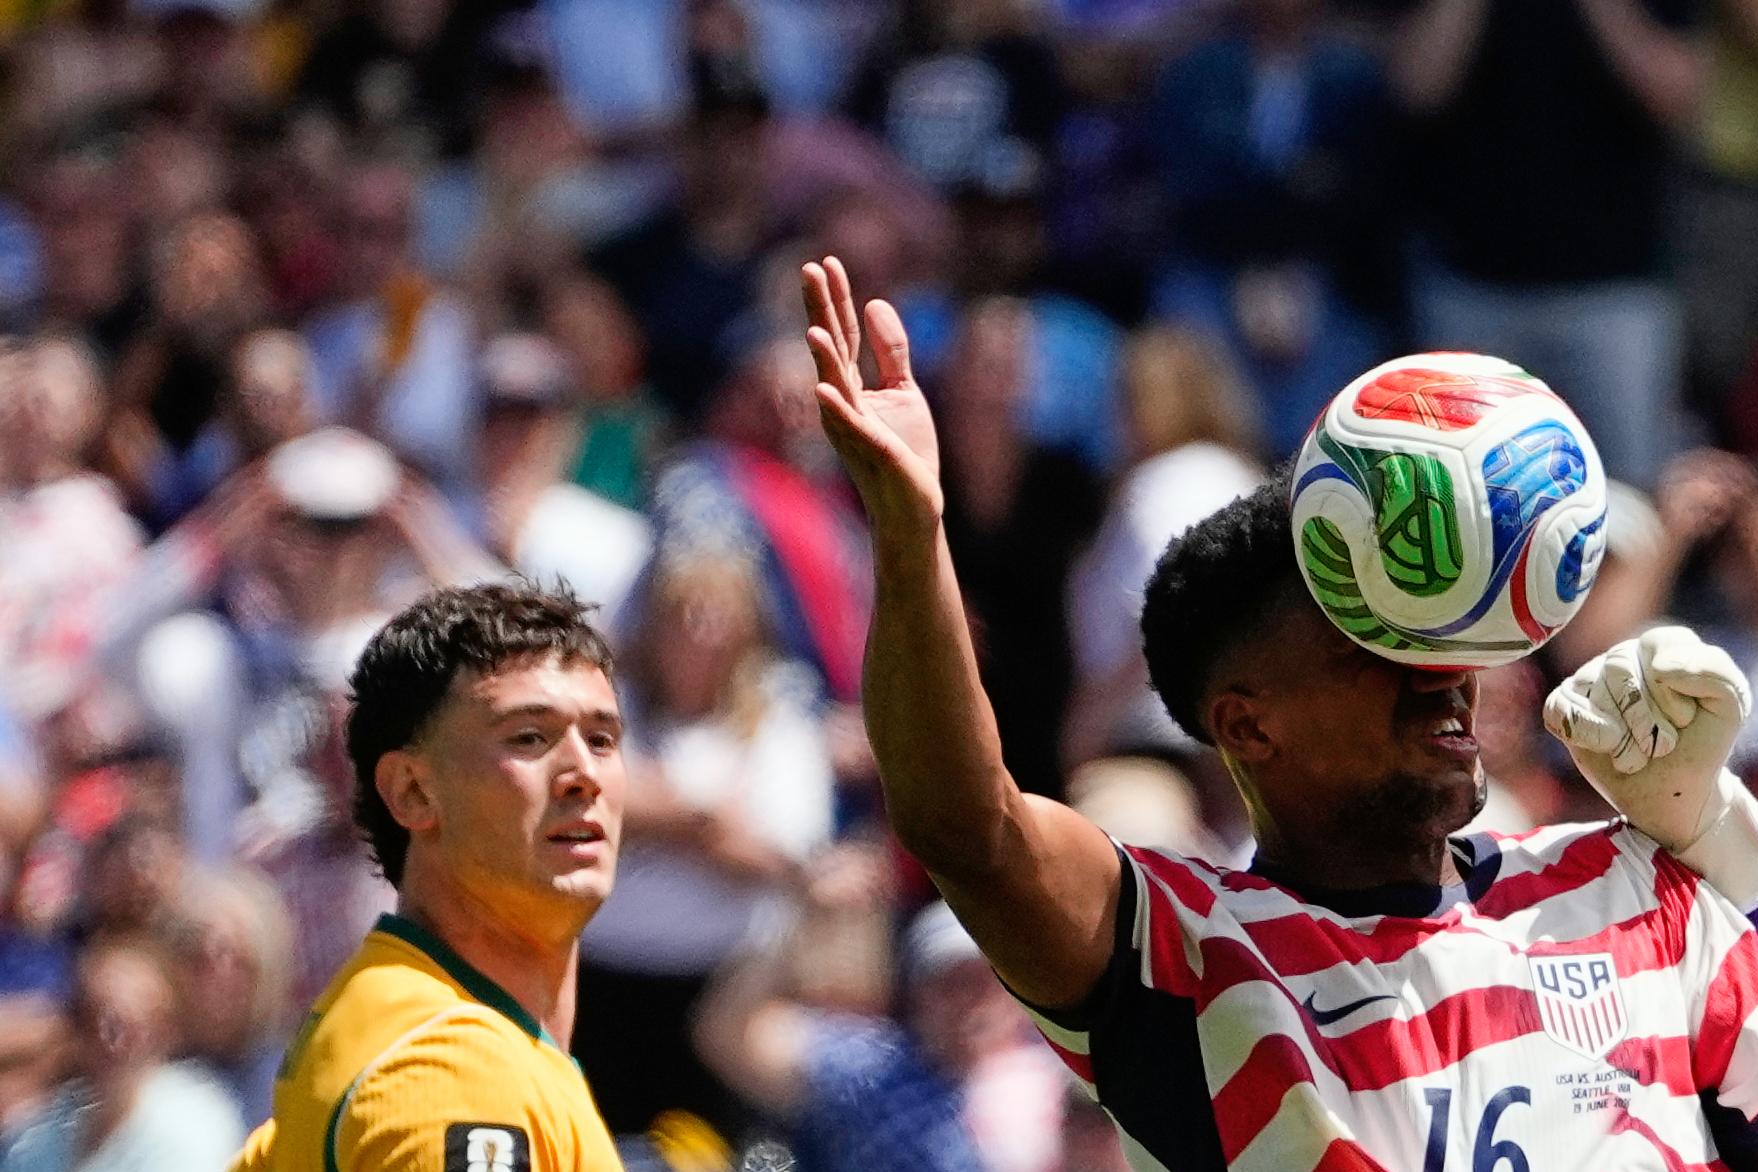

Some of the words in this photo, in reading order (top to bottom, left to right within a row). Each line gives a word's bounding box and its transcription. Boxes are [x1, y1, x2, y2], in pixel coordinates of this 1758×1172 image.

[1536, 960, 1611, 1000] USA
[1555, 1073, 1574, 1085] USA
[1586, 1099, 1608, 1112] JUNE
